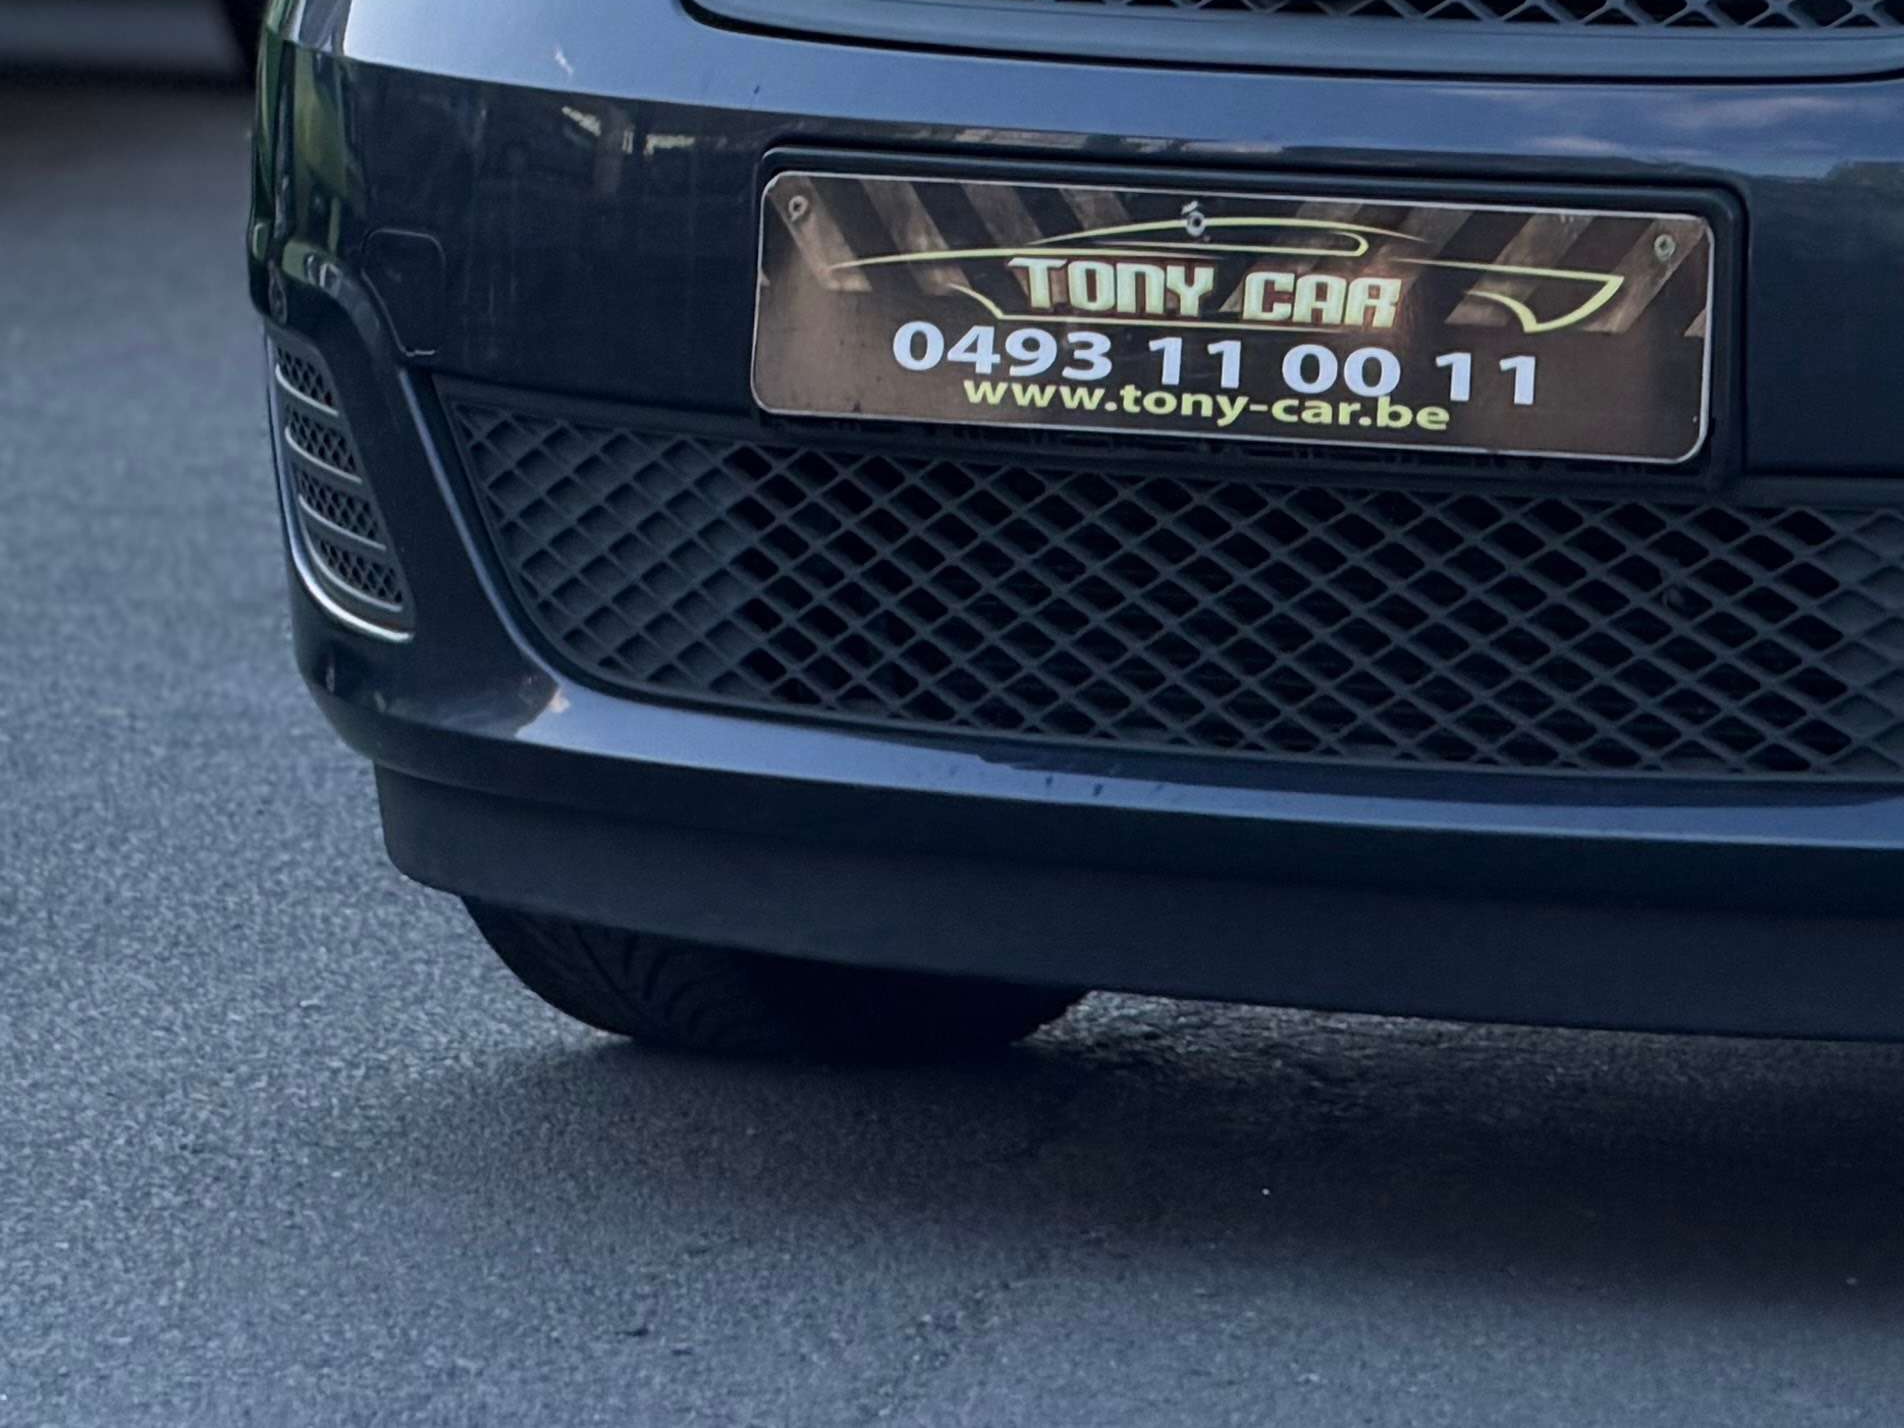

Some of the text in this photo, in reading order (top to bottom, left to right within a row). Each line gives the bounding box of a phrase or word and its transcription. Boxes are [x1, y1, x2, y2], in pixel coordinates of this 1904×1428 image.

[1006, 255, 1404, 329] TONY CAR
[891, 319, 1537, 406] 0493 11 00 11
[964, 378, 1451, 432] www.tony-car.be
